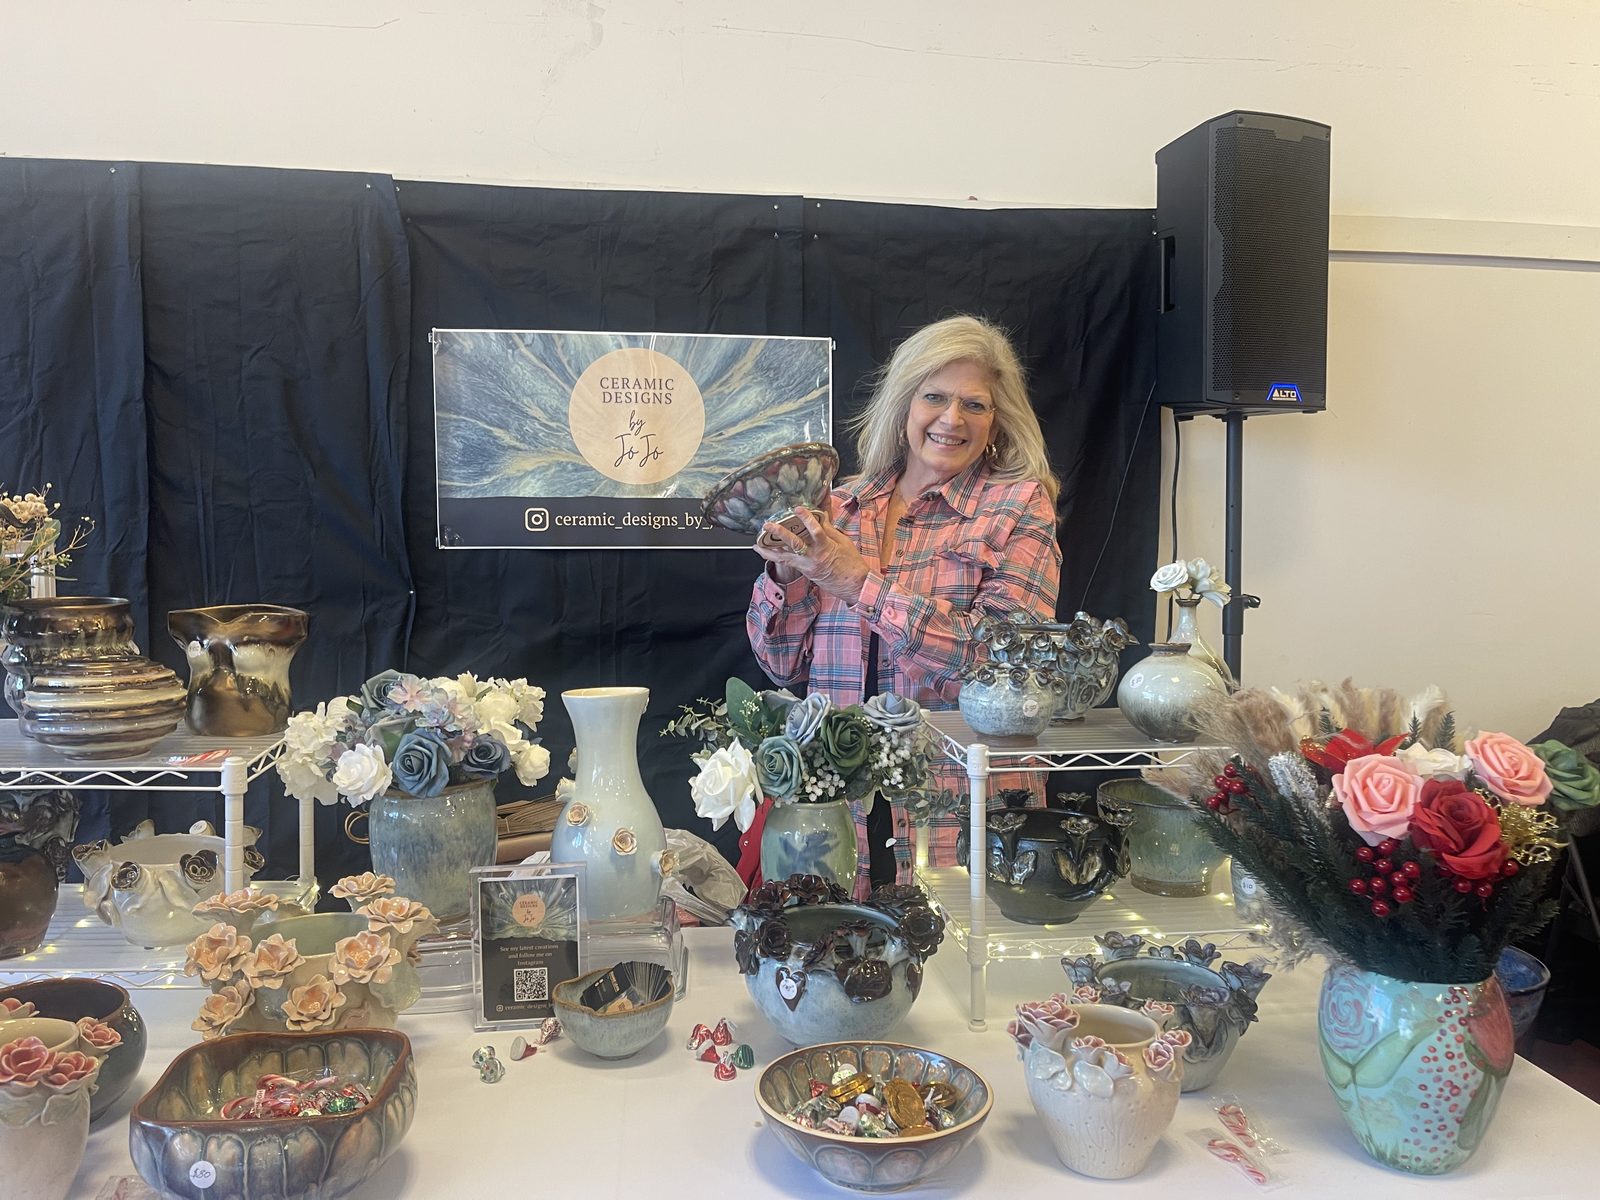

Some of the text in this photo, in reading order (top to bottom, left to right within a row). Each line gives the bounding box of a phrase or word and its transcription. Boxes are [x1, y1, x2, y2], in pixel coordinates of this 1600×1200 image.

[599, 376, 675, 391] CERAMIC
[602, 391, 673, 405] DESIGNS
[1272, 388, 1297, 398] ALTO
[628, 409, 646, 437] by
[554, 512, 714, 530] ceramic_designs_by_
